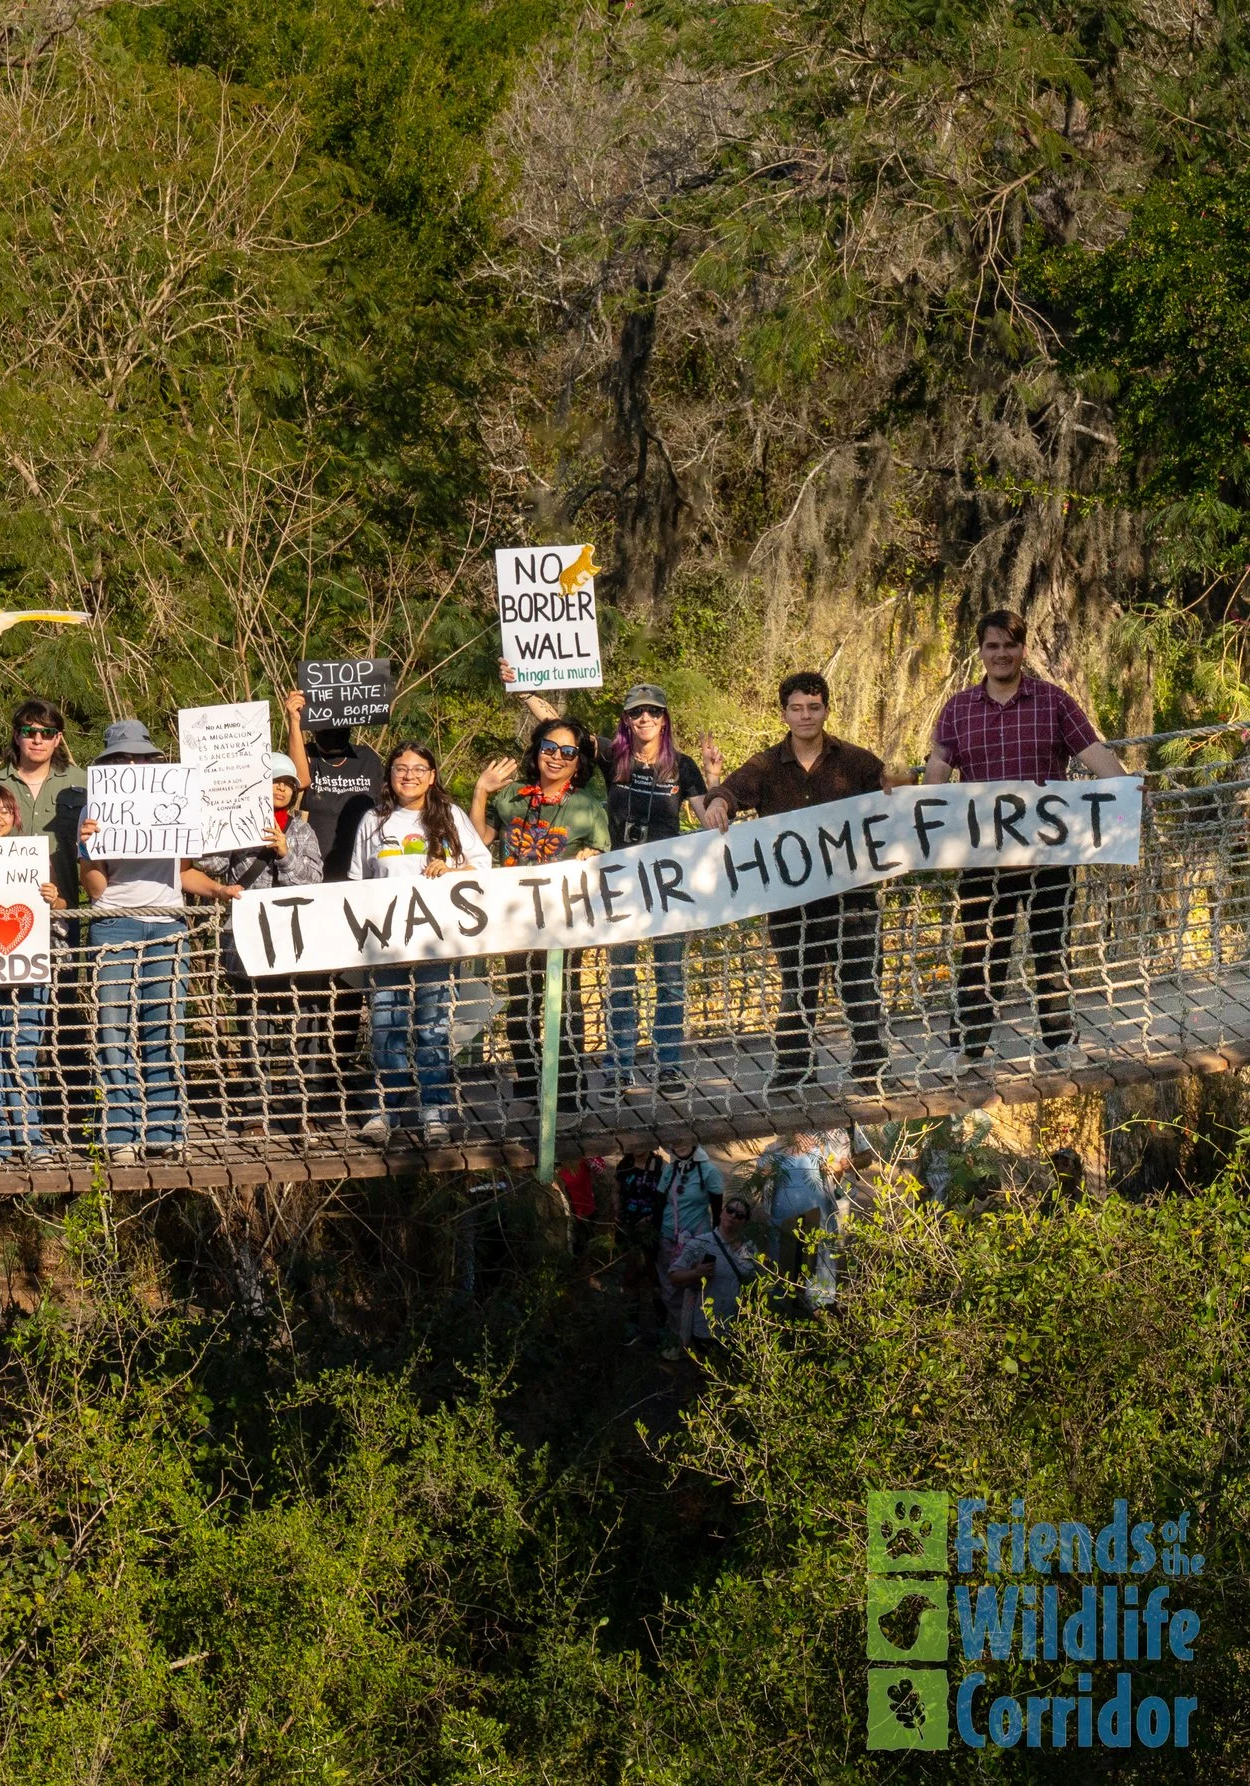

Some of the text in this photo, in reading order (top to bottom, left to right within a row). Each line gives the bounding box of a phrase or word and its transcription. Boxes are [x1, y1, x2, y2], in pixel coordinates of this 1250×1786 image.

[515, 553, 563, 585] NO
[502, 591, 595, 623] BORDER
[515, 632, 591, 660] WALL
[307, 661, 374, 685] STOP
[553, 667, 565, 680] tu
[567, 659, 600, 679] muro!
[307, 684, 387, 702] THE HATE!
[308, 704, 389, 719] NO BORDER
[332, 715, 371, 726] WALLS!
[91, 767, 197, 795] PROTECT
[90, 800, 141, 825] OUR
[8, 841, 39, 857] Ana
[6, 868, 41, 888] NWR
[259, 792, 1117, 968] IT WAS THEIR HOME FIRST
